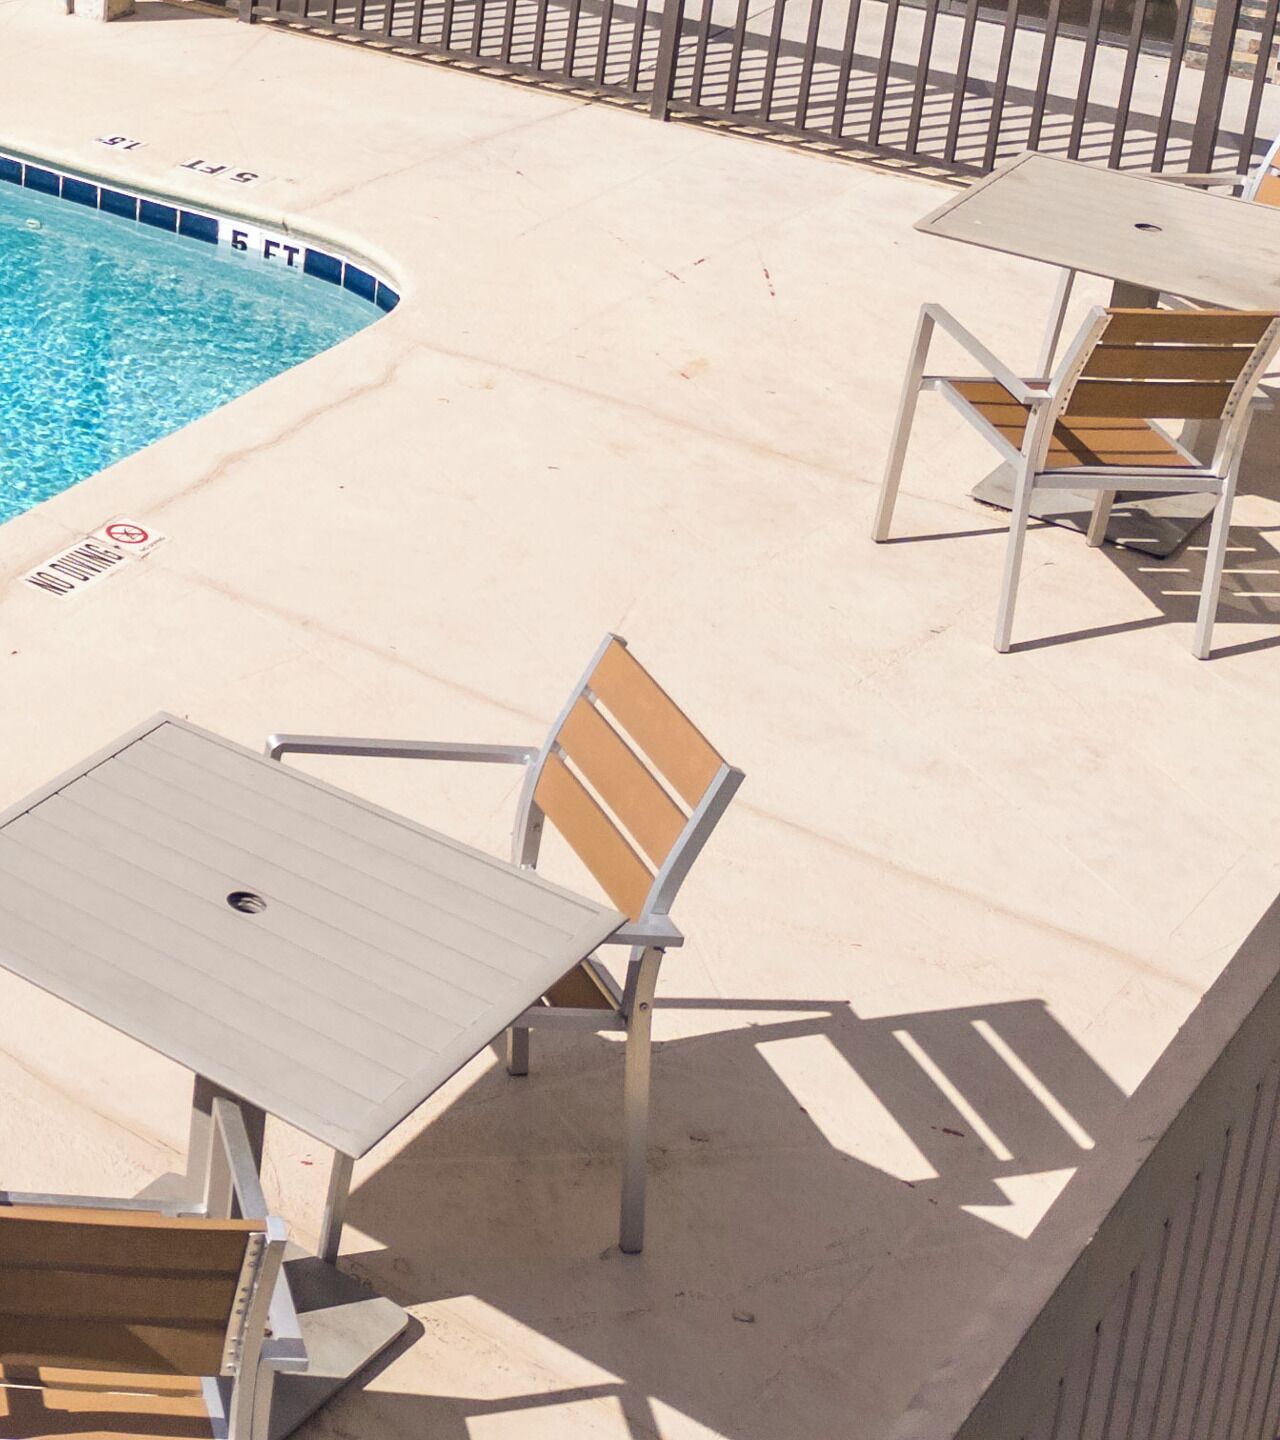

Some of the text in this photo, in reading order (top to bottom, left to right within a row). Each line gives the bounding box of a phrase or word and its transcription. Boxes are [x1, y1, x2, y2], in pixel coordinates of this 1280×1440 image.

[101, 135, 142, 151] 1.5
[181, 159, 260, 183] 5 FT
[231, 229, 300, 267] 5 FT
[48, 543, 125, 582] DIVING
[24, 571, 76, 596] NO
